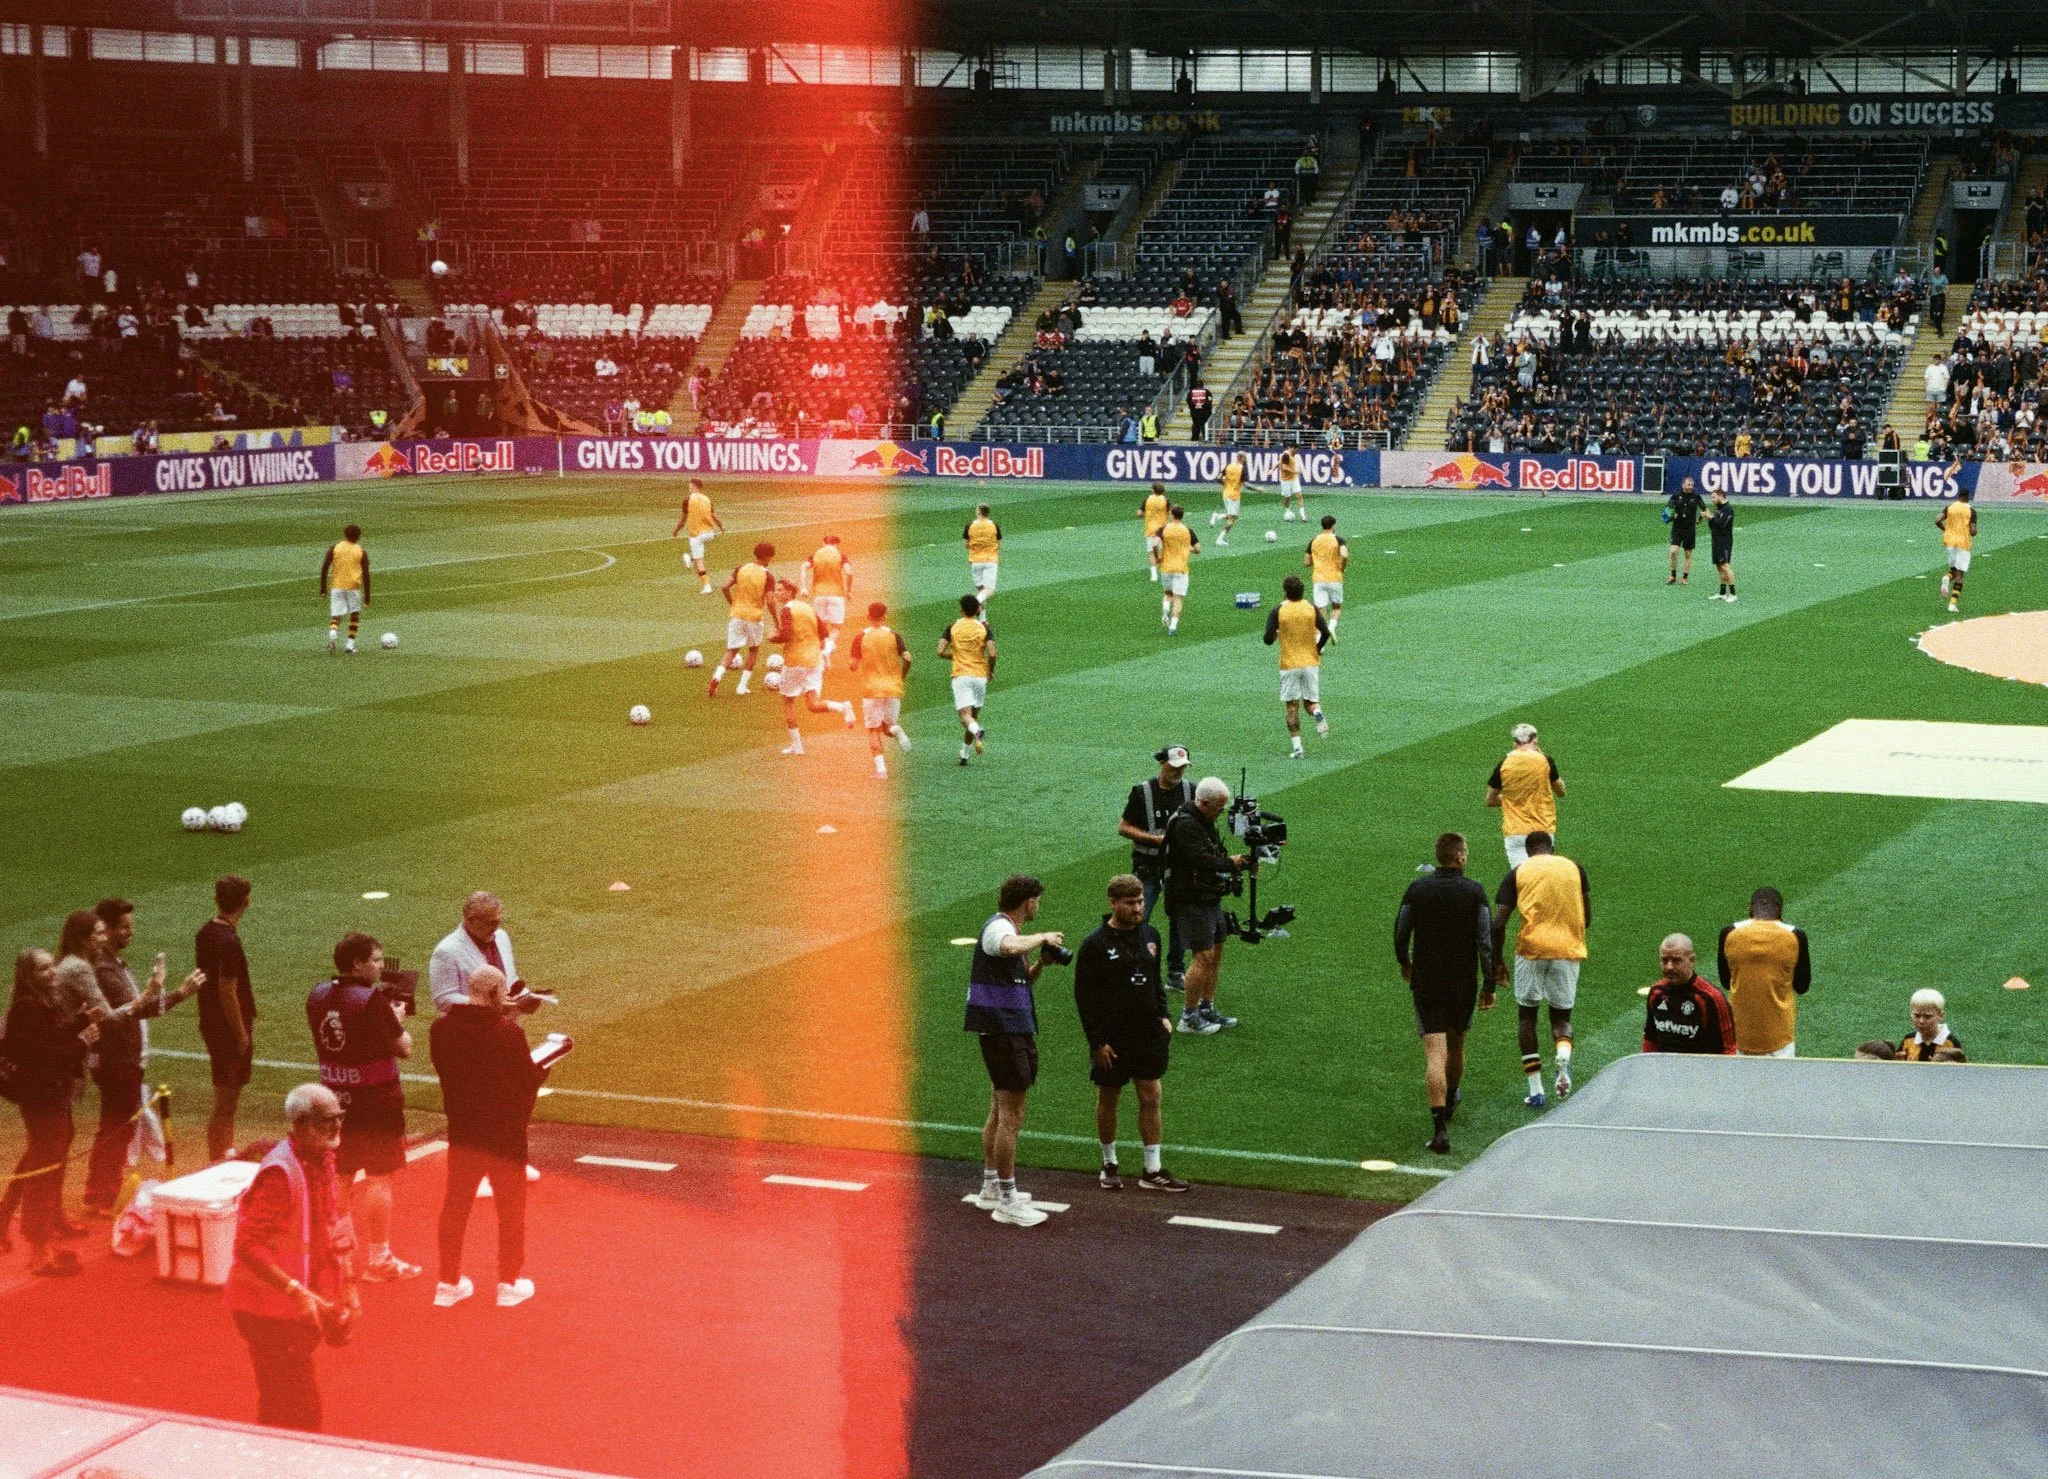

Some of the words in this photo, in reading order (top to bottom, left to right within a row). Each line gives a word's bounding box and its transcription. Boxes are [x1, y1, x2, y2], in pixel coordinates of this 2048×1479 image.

[1730, 102, 1840, 127] BUILDING
[1849, 102, 1881, 125] ON
[1890, 101, 1994, 125] SUCCESS
[1652, 221, 1815, 243] mkmbs.co.uk
[427, 357, 469, 377] MKM
[577, 440, 644, 469] GIVES
[650, 441, 700, 470] YOU
[706, 442, 809, 472] WIIINGS.
[1106, 450, 1178, 480] GIVES
[156, 458, 206, 491] GIVES
[210, 454, 245, 487] YOU
[1701, 462, 1777, 493] GIVES
[1784, 463, 1842, 495] YOU
